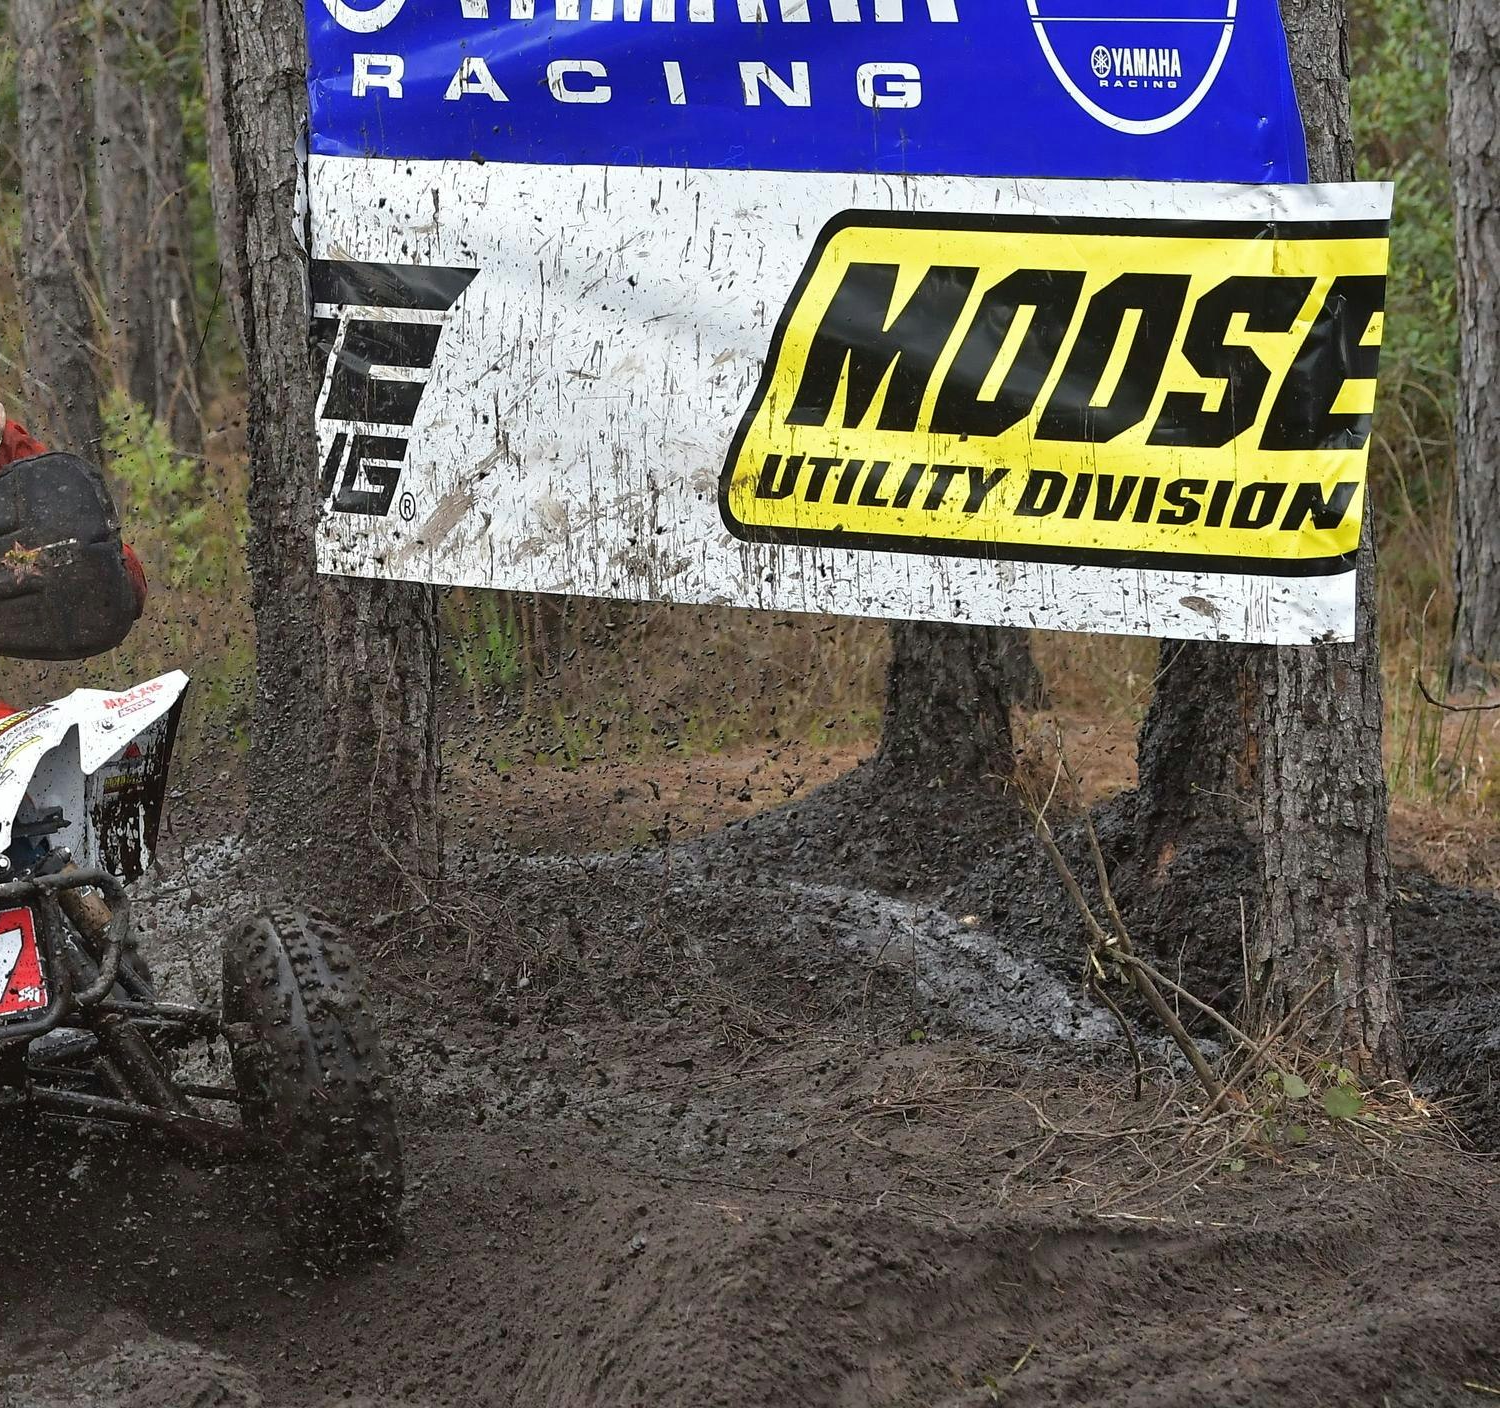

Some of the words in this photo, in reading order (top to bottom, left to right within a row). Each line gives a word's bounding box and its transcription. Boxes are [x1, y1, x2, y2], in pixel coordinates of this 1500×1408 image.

[351, 53, 922, 108] RACING
[1099, 80, 1177, 89] RACING
[1111, 47, 1182, 78] YAMAHA
[784, 261, 1387, 451] MOOSE
[756, 454, 1011, 514] UTILITY
[1013, 469, 1361, 532] DIVISION
